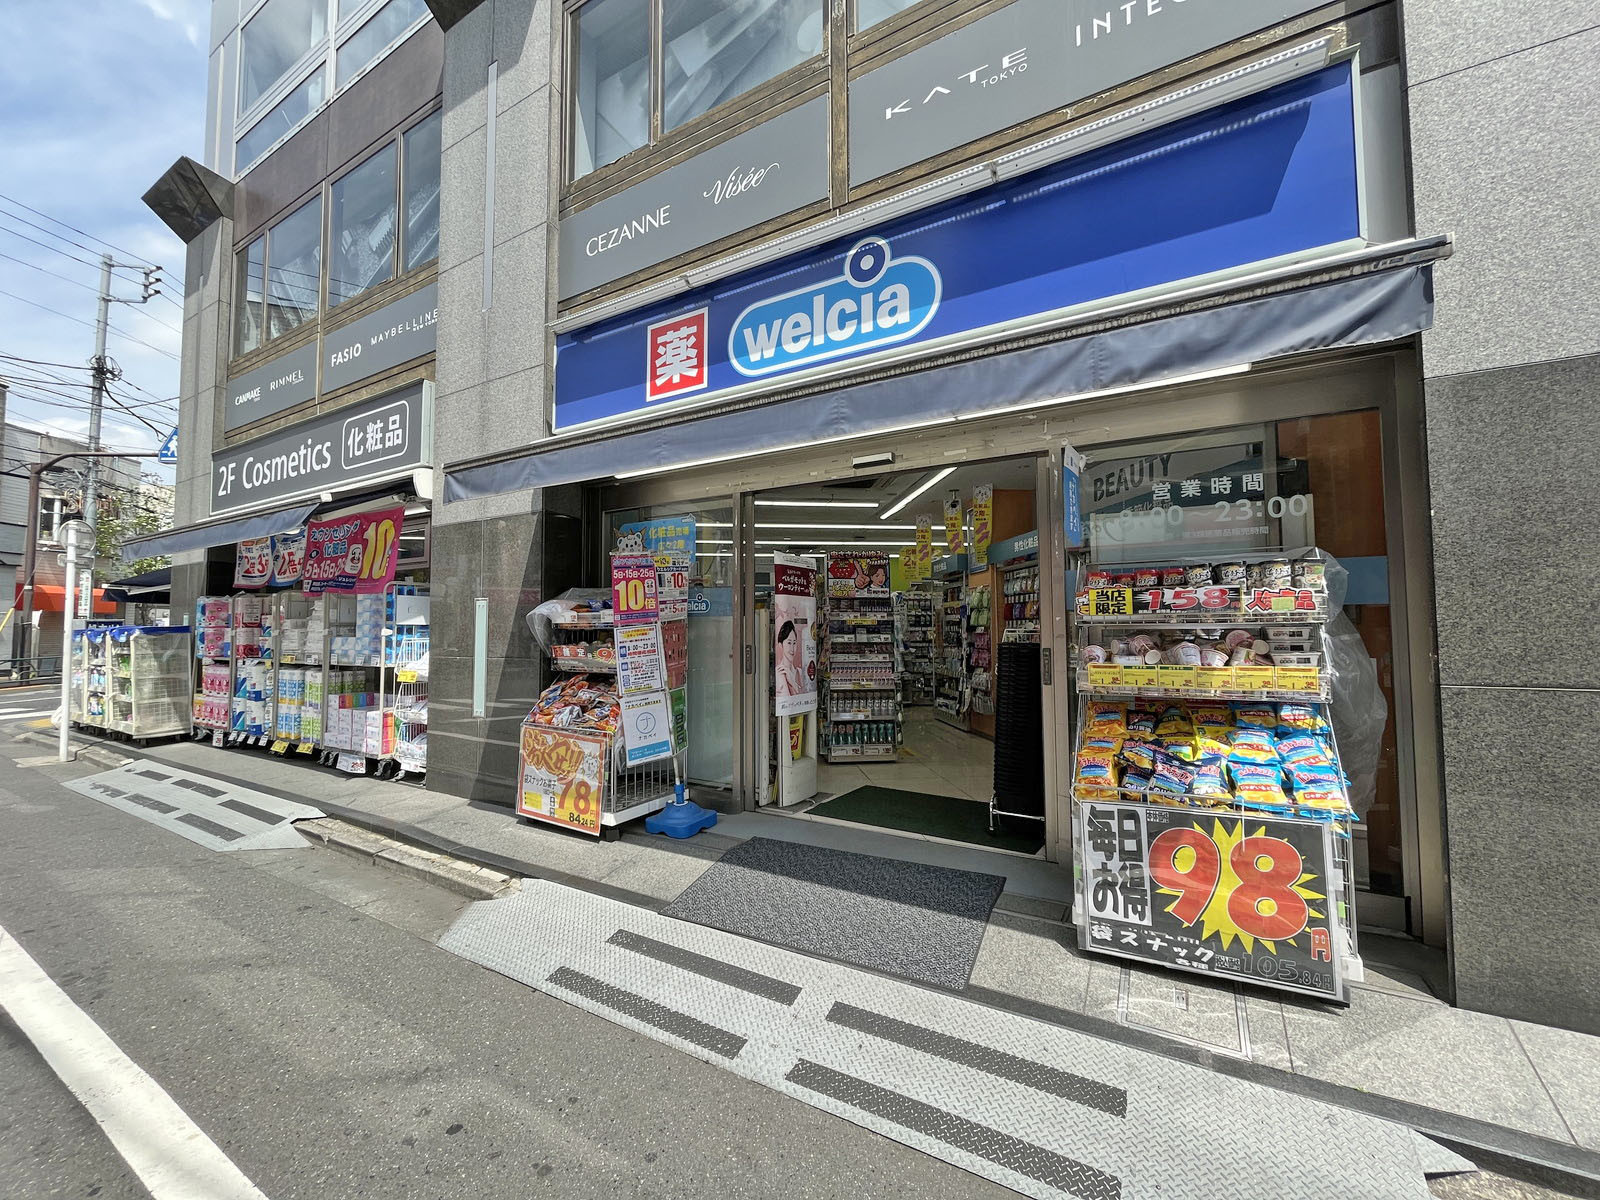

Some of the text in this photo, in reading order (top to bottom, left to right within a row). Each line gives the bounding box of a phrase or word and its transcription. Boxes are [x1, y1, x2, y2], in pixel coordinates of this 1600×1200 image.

[1075, 0, 1187, 46] INTE
[885, 47, 1028, 120] KATE
[980, 62, 1029, 88] TOKYO
[703, 162, 780, 204] Visée
[586, 205, 671, 257] CEZANNE
[371, 308, 438, 346] MAYBELLINE
[743, 283, 910, 362] welcia
[331, 343, 362, 368] FASIO
[655, 325, 699, 387] 薬
[270, 369, 304, 391] RIMMEL
[217, 414, 402, 497] 2F Cosmetics 化粧品
[1093, 453, 1172, 502] BEAUTY
[1152, 472, 1265, 501] 営業時間
[614, 579, 645, 611] 10
[688, 601, 707, 611] elcia
[1096, 590, 1127, 602] 当店
[1096, 603, 1127, 615] 限定
[1147, 588, 1230, 610] 158
[559, 779, 592, 815] 78
[1149, 827, 1332, 963] 98 円
[1091, 924, 1215, 963] 袋スナック
